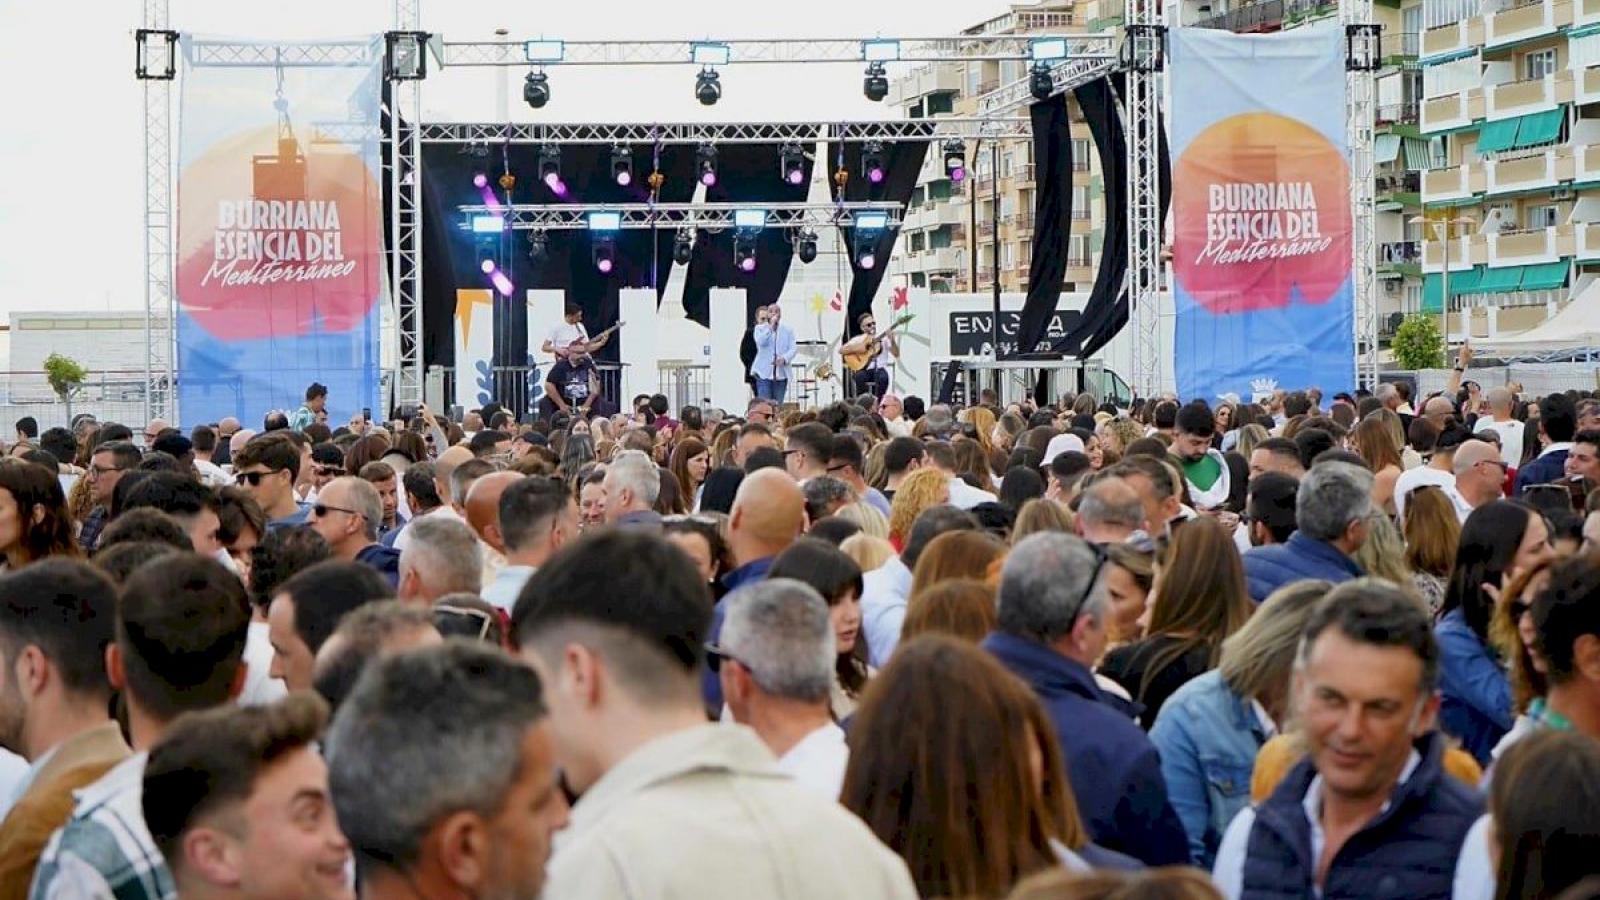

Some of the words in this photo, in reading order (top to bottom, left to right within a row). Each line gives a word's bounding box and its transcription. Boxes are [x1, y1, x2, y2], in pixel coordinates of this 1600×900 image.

[1208, 181, 1317, 212] BURRIANA
[218, 200, 341, 230] BURRIANA
[1207, 212, 1283, 241] ESENCIA
[1287, 210, 1321, 239] DEL
[215, 231, 302, 260] ESENCIA
[306, 231, 345, 260] DEL
[1194, 236, 1333, 266] Mediterráneo
[200, 257, 357, 288] Mediterráneo
